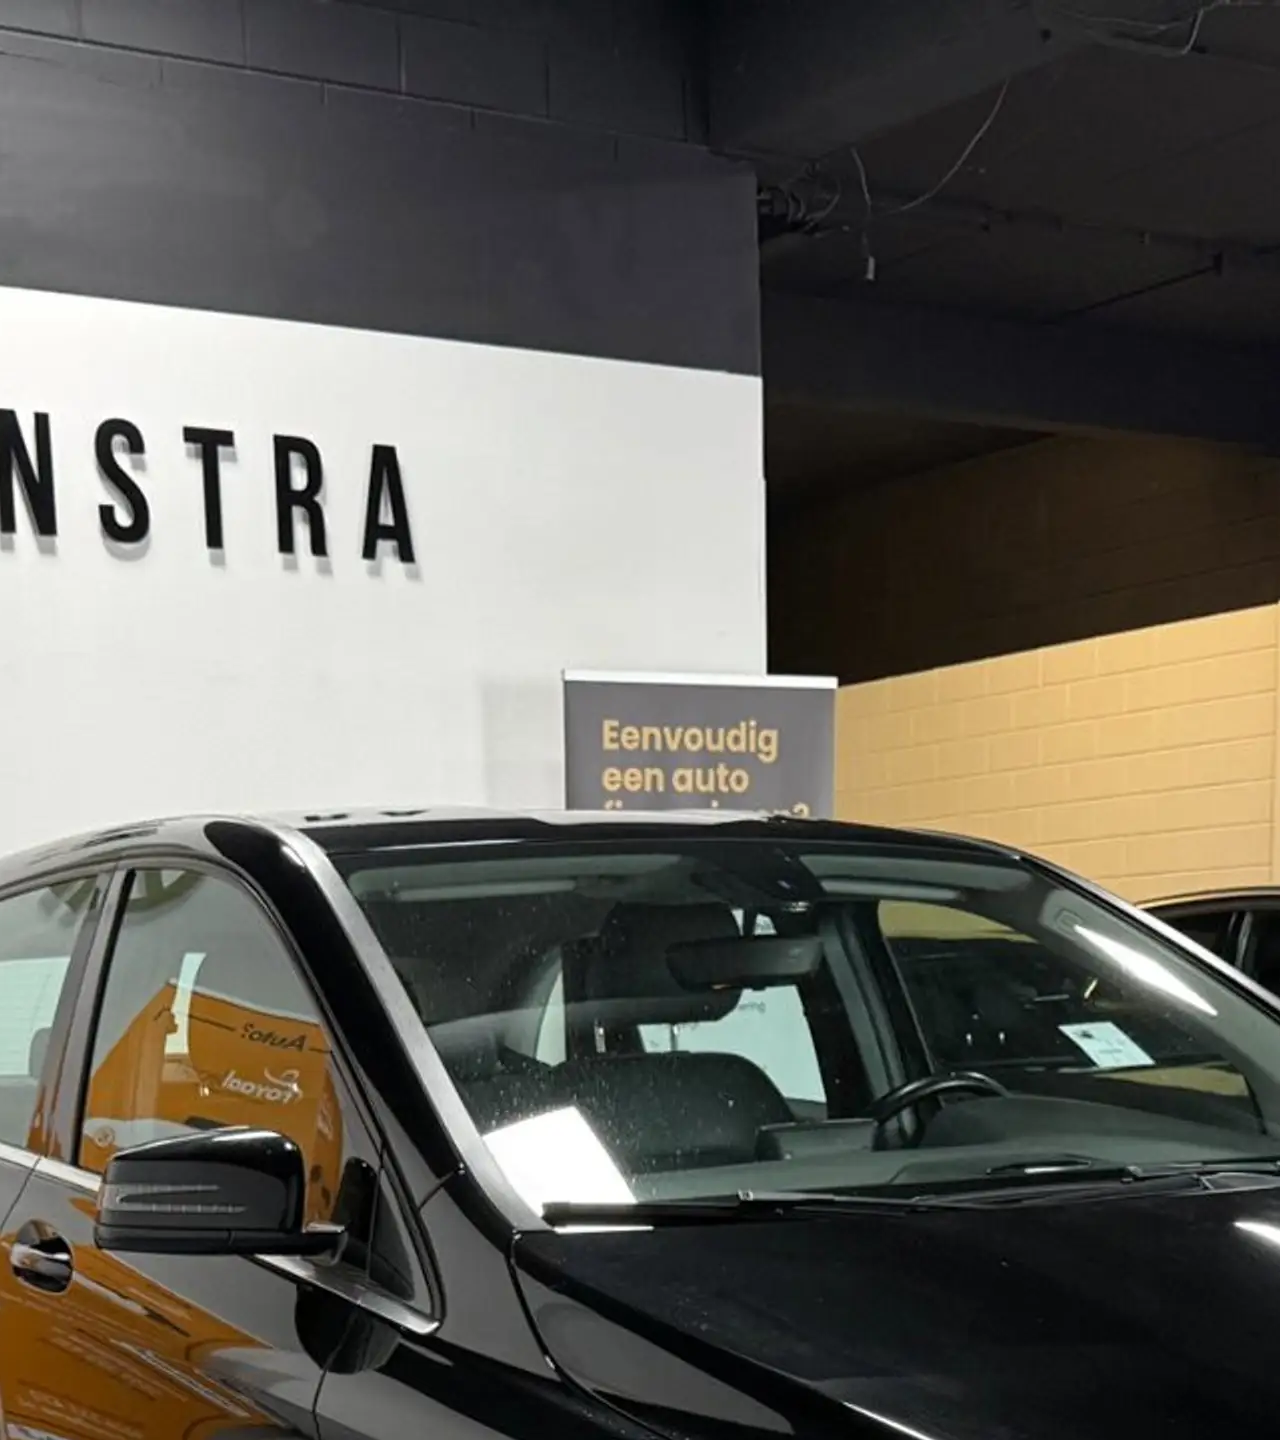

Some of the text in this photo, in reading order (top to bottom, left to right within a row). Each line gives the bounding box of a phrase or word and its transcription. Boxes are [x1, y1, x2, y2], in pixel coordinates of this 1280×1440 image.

[602, 719, 778, 763] Eenvoudig
[602, 763, 749, 792] een auto
